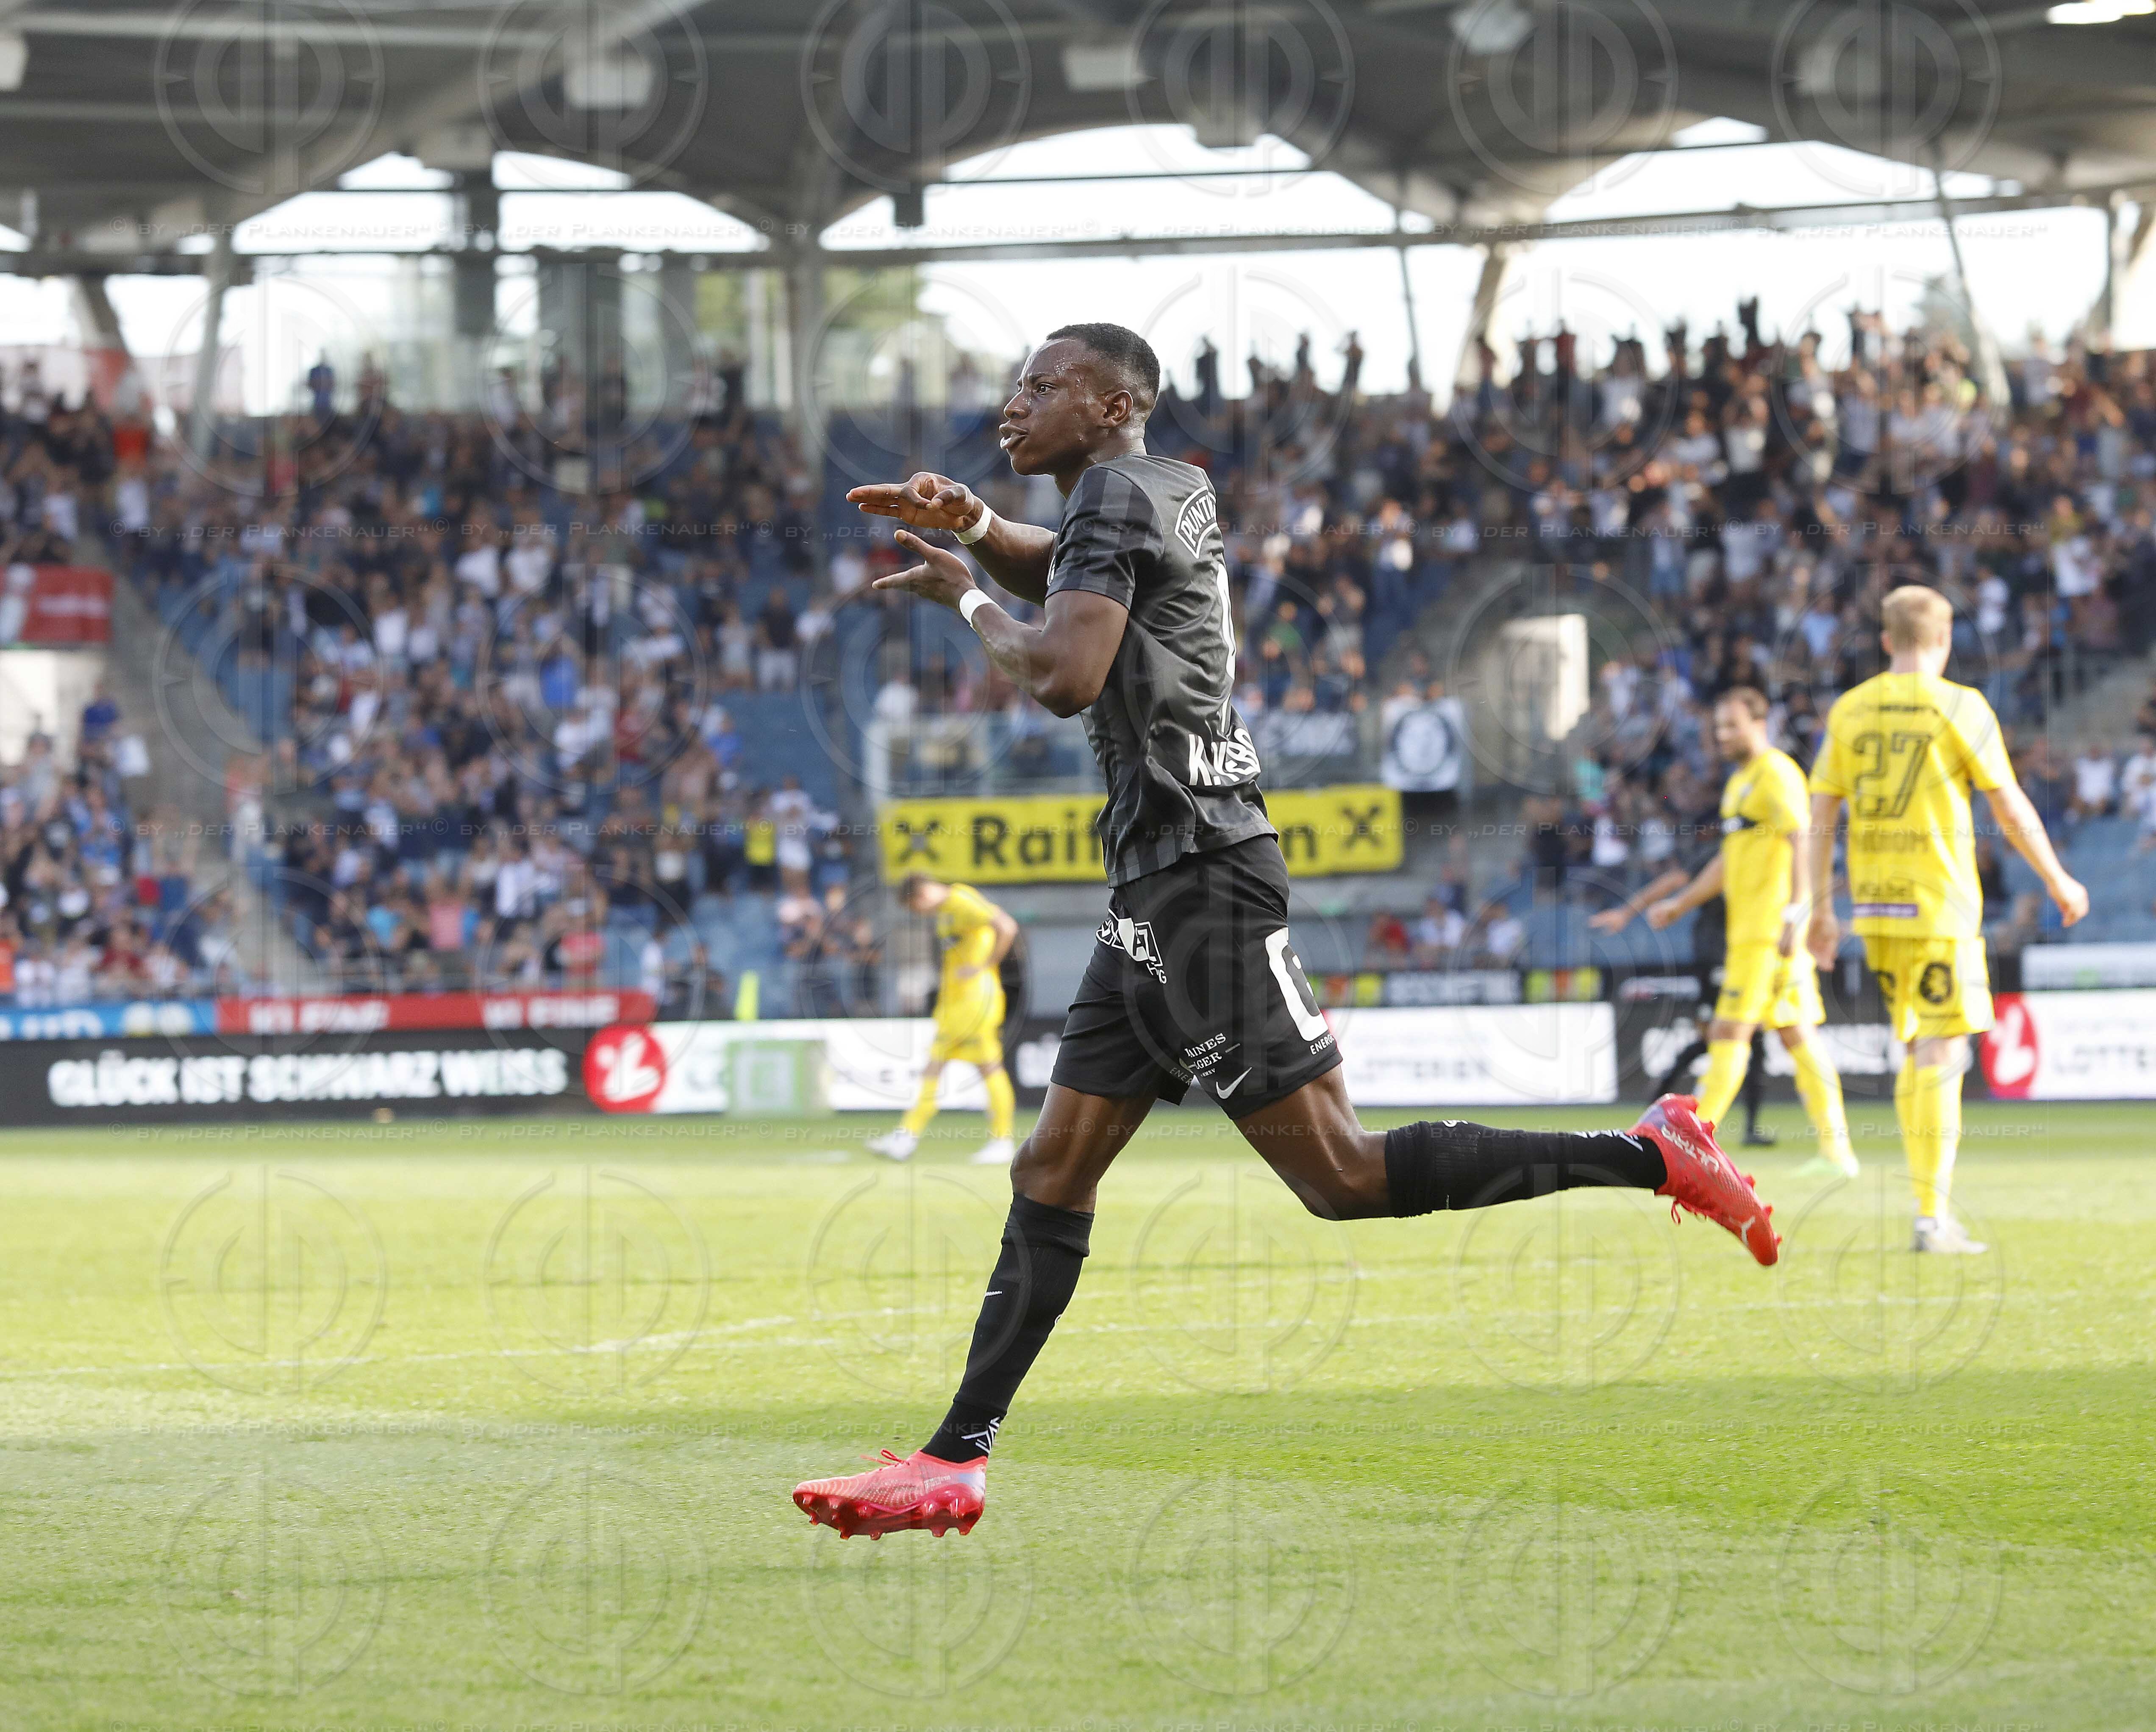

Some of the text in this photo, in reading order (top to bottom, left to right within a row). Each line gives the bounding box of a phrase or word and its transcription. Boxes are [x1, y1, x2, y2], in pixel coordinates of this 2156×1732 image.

[1853, 732, 1933, 819] 27
[48, 1047, 568, 1106] GLÜCK IST SCHWARZ WEISS
